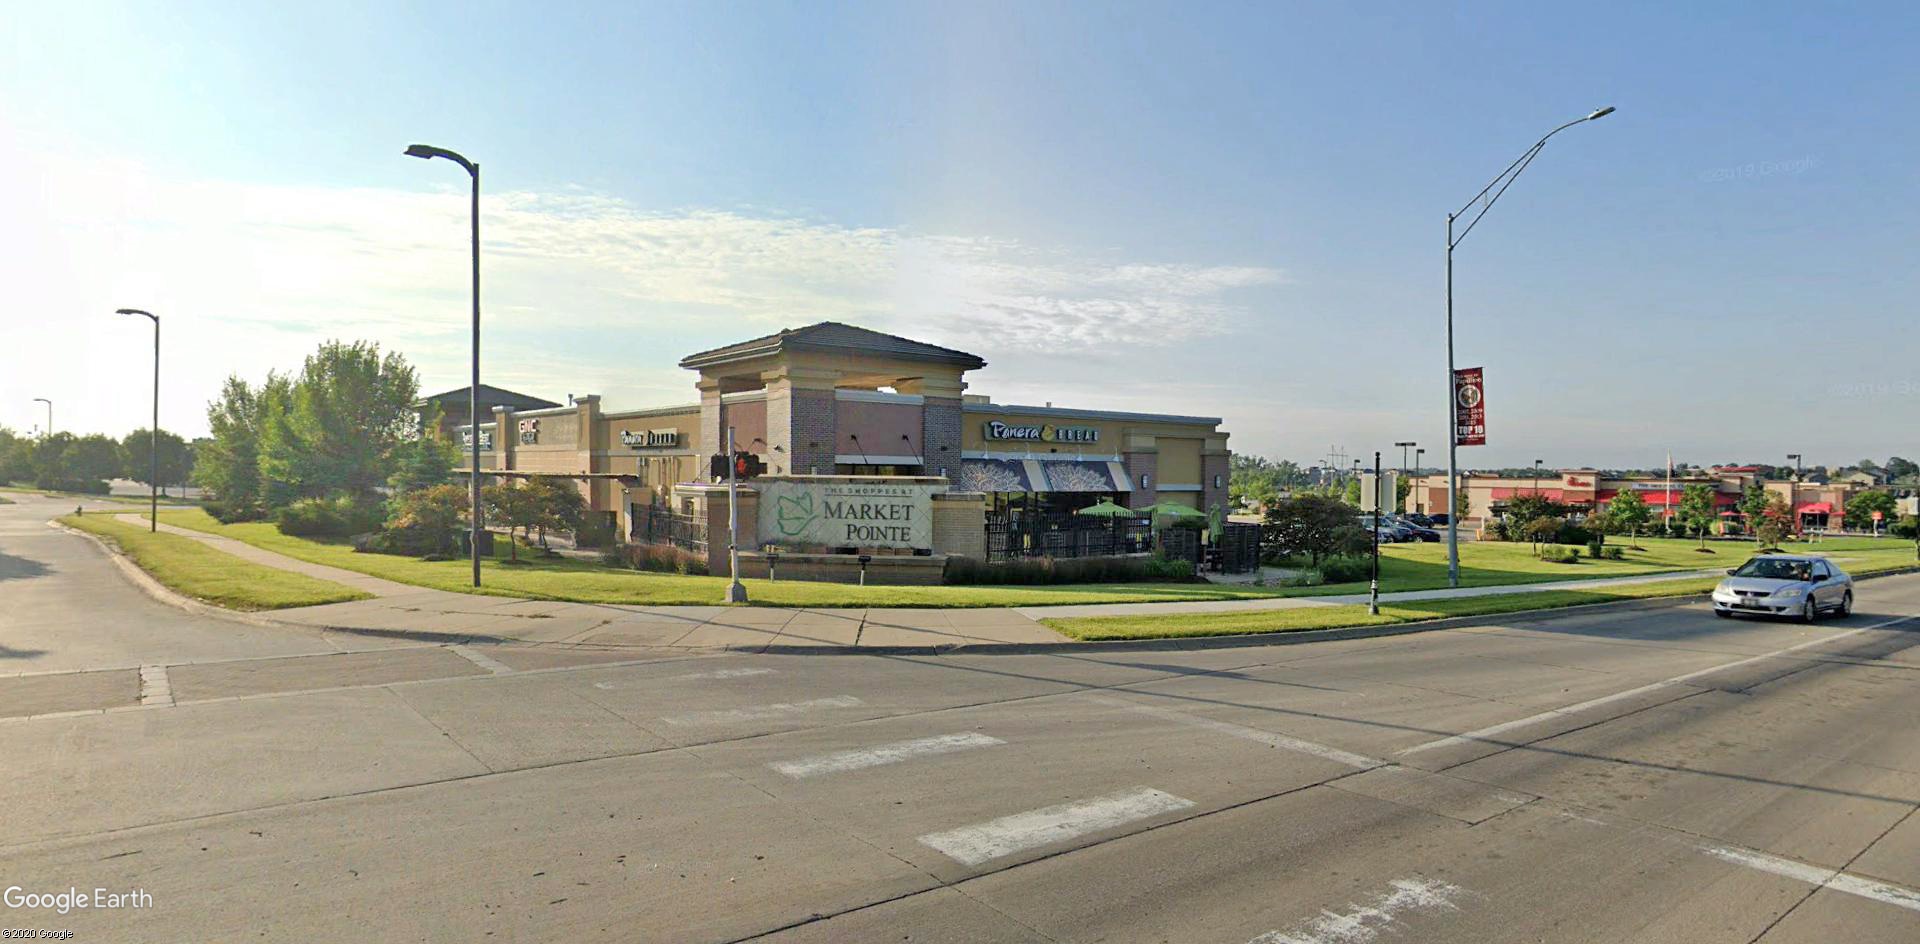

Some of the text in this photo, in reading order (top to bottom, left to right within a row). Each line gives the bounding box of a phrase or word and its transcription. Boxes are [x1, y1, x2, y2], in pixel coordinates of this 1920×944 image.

[518, 419, 537, 432] GNC
[990, 421, 1040, 439] Panera
[1458, 425, 1484, 435] TOP 10
[823, 501, 915, 521] MARKET
[846, 523, 911, 542] POINTE
